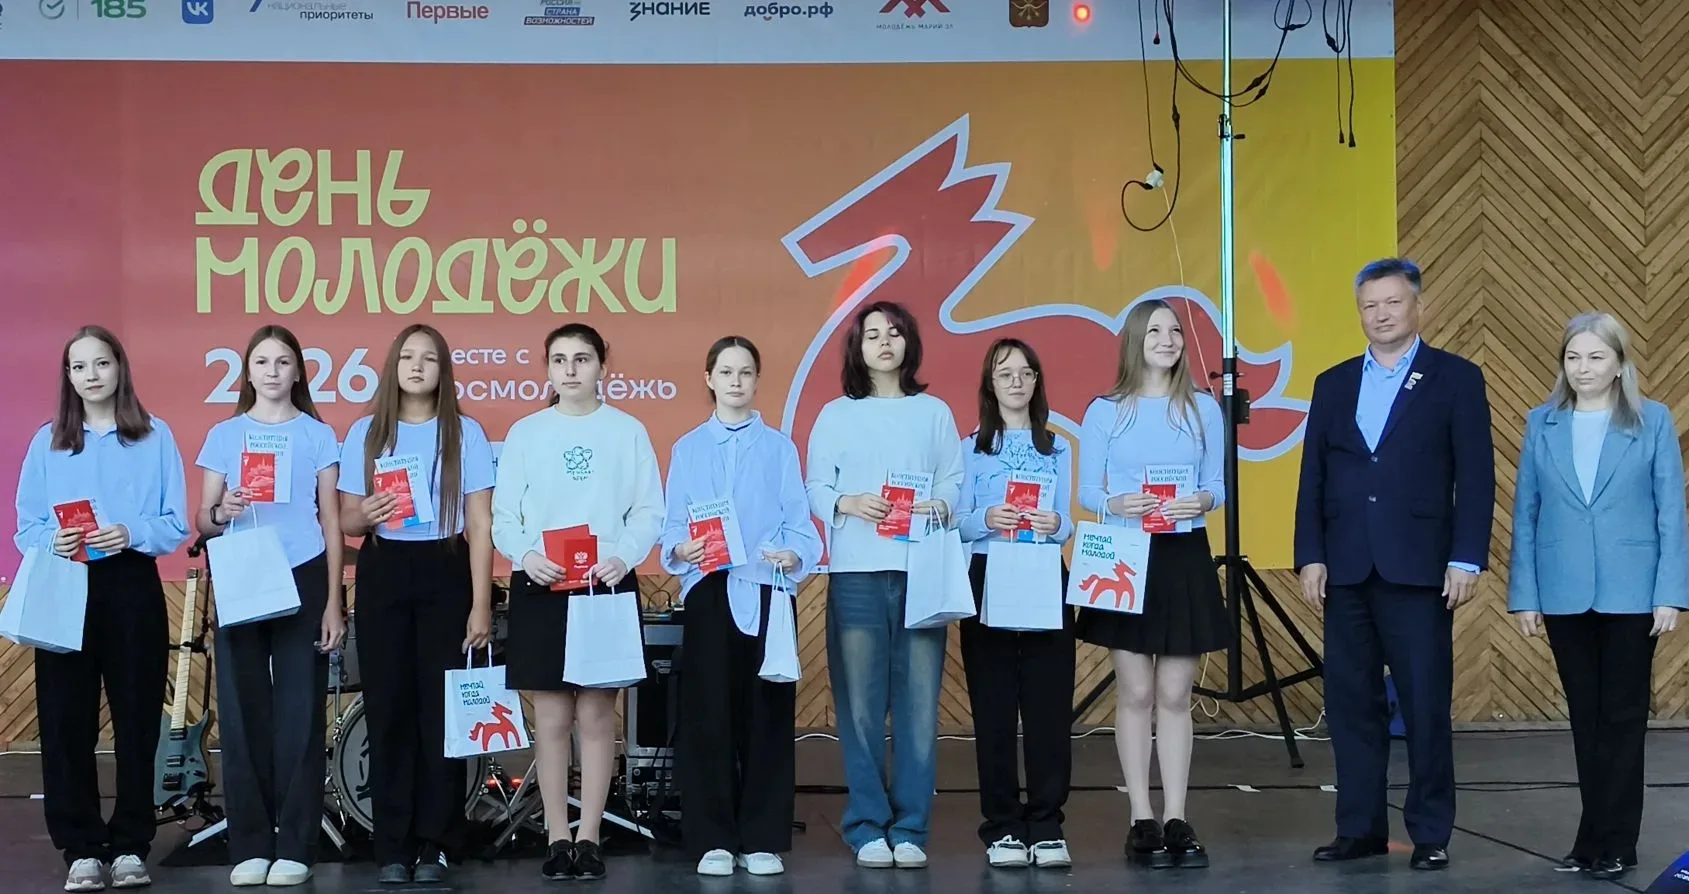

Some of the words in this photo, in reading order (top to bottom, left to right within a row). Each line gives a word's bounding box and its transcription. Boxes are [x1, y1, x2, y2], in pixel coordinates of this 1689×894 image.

[91, 0, 147, 19] 185
[300, 11, 374, 20] приоритеты
[407, 1, 489, 24] Первые
[744, 2, 834, 18] добро.рф
[525, 17, 593, 25] ВОЗМОЖНОСТЕЙ
[451, 349, 507, 364] есте
[515, 349, 530, 364] с
[204, 347, 379, 403] 226
